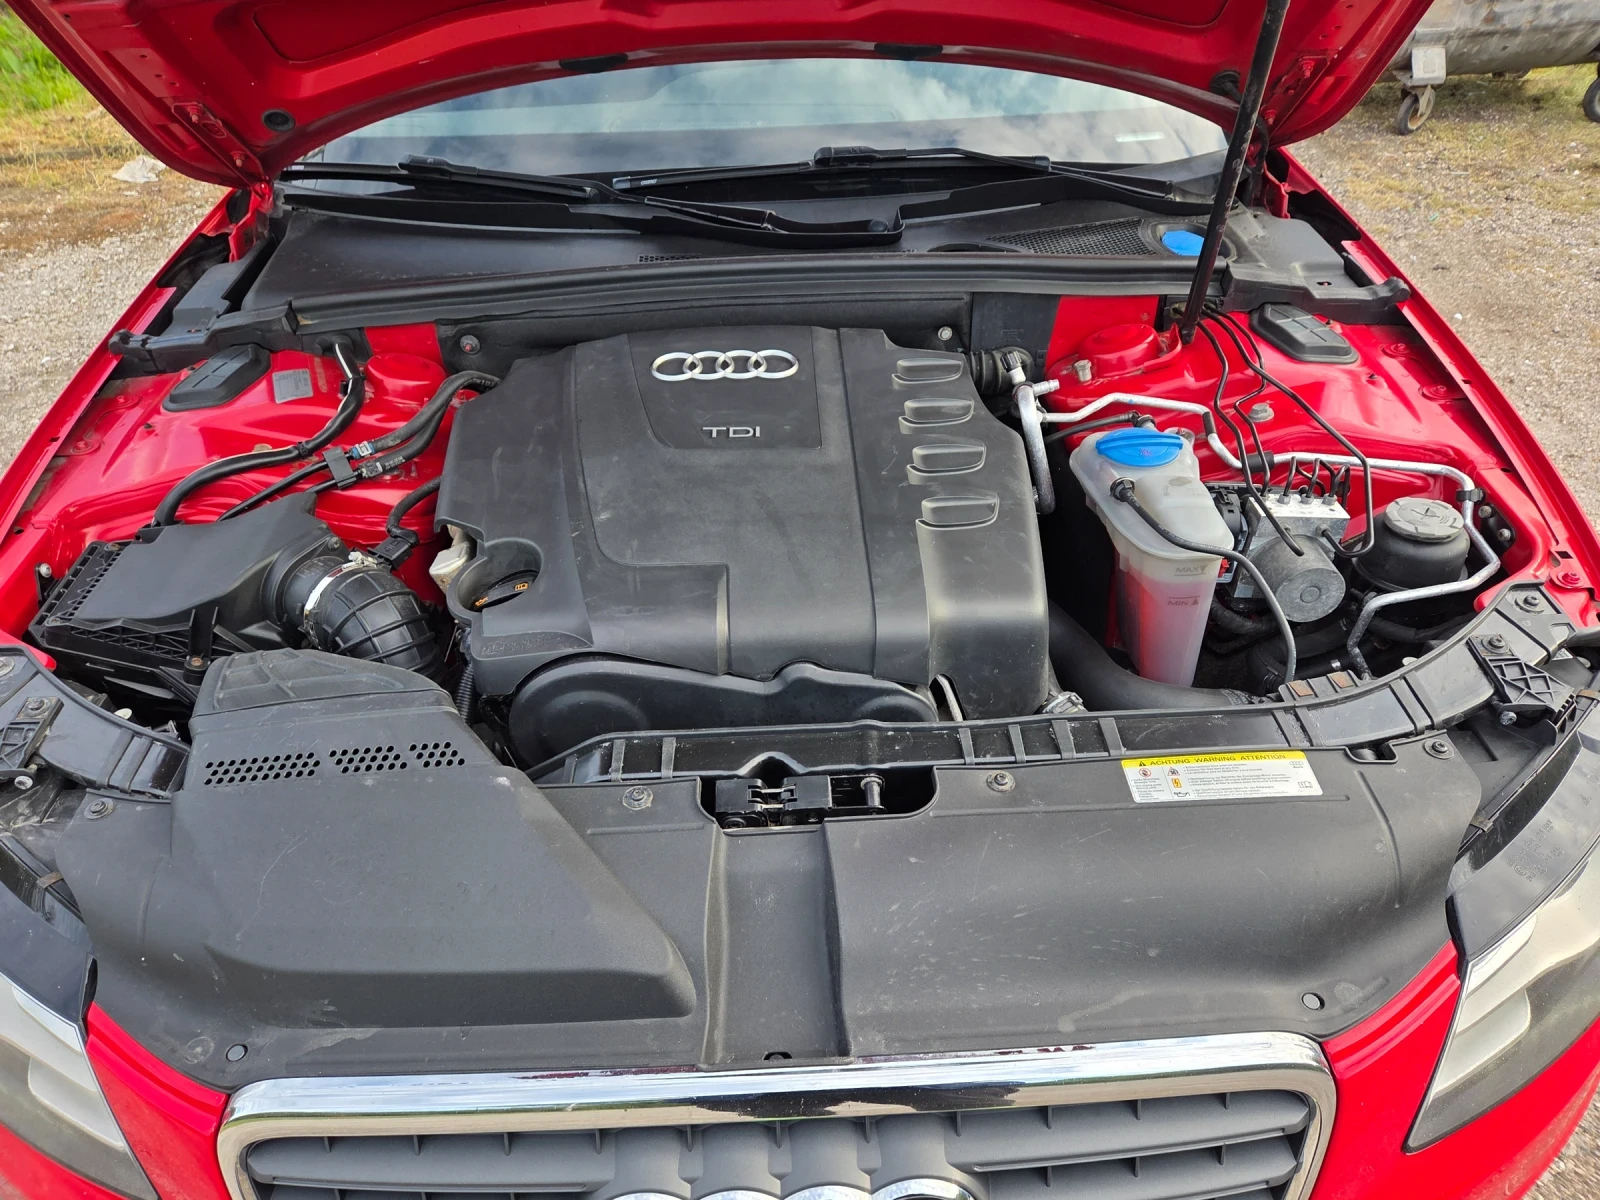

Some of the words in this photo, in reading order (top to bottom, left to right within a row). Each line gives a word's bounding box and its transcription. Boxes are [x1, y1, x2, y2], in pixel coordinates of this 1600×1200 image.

[702, 426, 761, 438] TDI
[1150, 758, 1191, 766] ACHTUNG
[1194, 755, 1236, 763] WARNING
